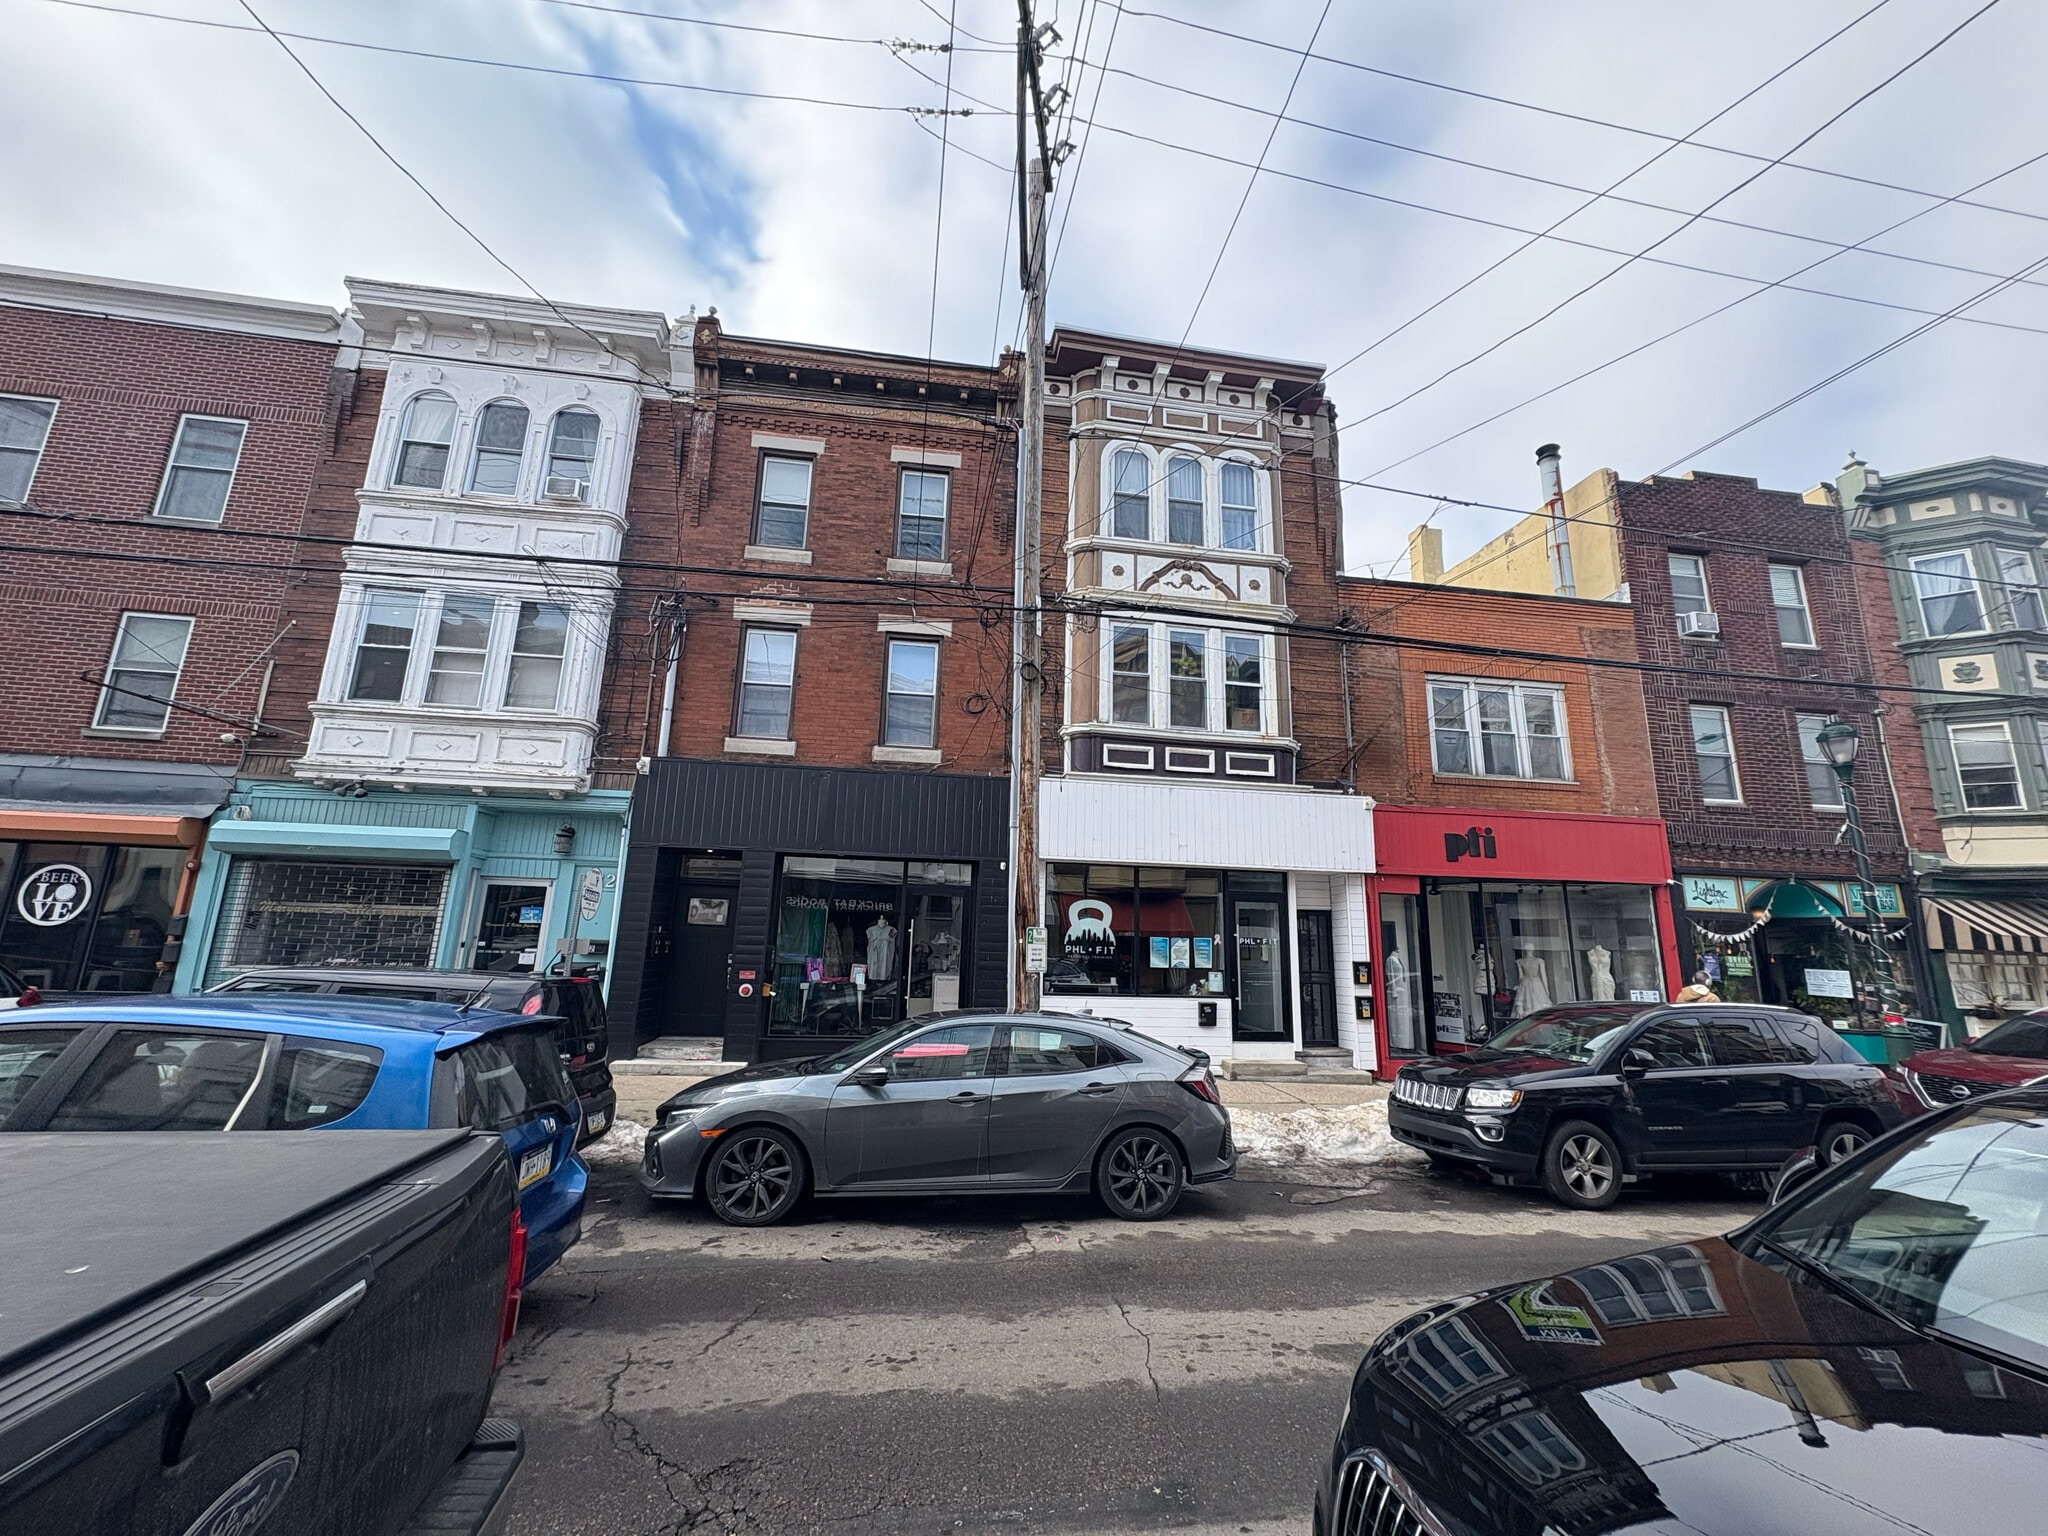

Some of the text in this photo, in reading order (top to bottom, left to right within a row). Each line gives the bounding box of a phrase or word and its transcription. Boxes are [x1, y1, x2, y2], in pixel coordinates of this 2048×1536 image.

[40, 872, 79, 883] BEER
[1065, 945, 1115, 954] PHL FIT
